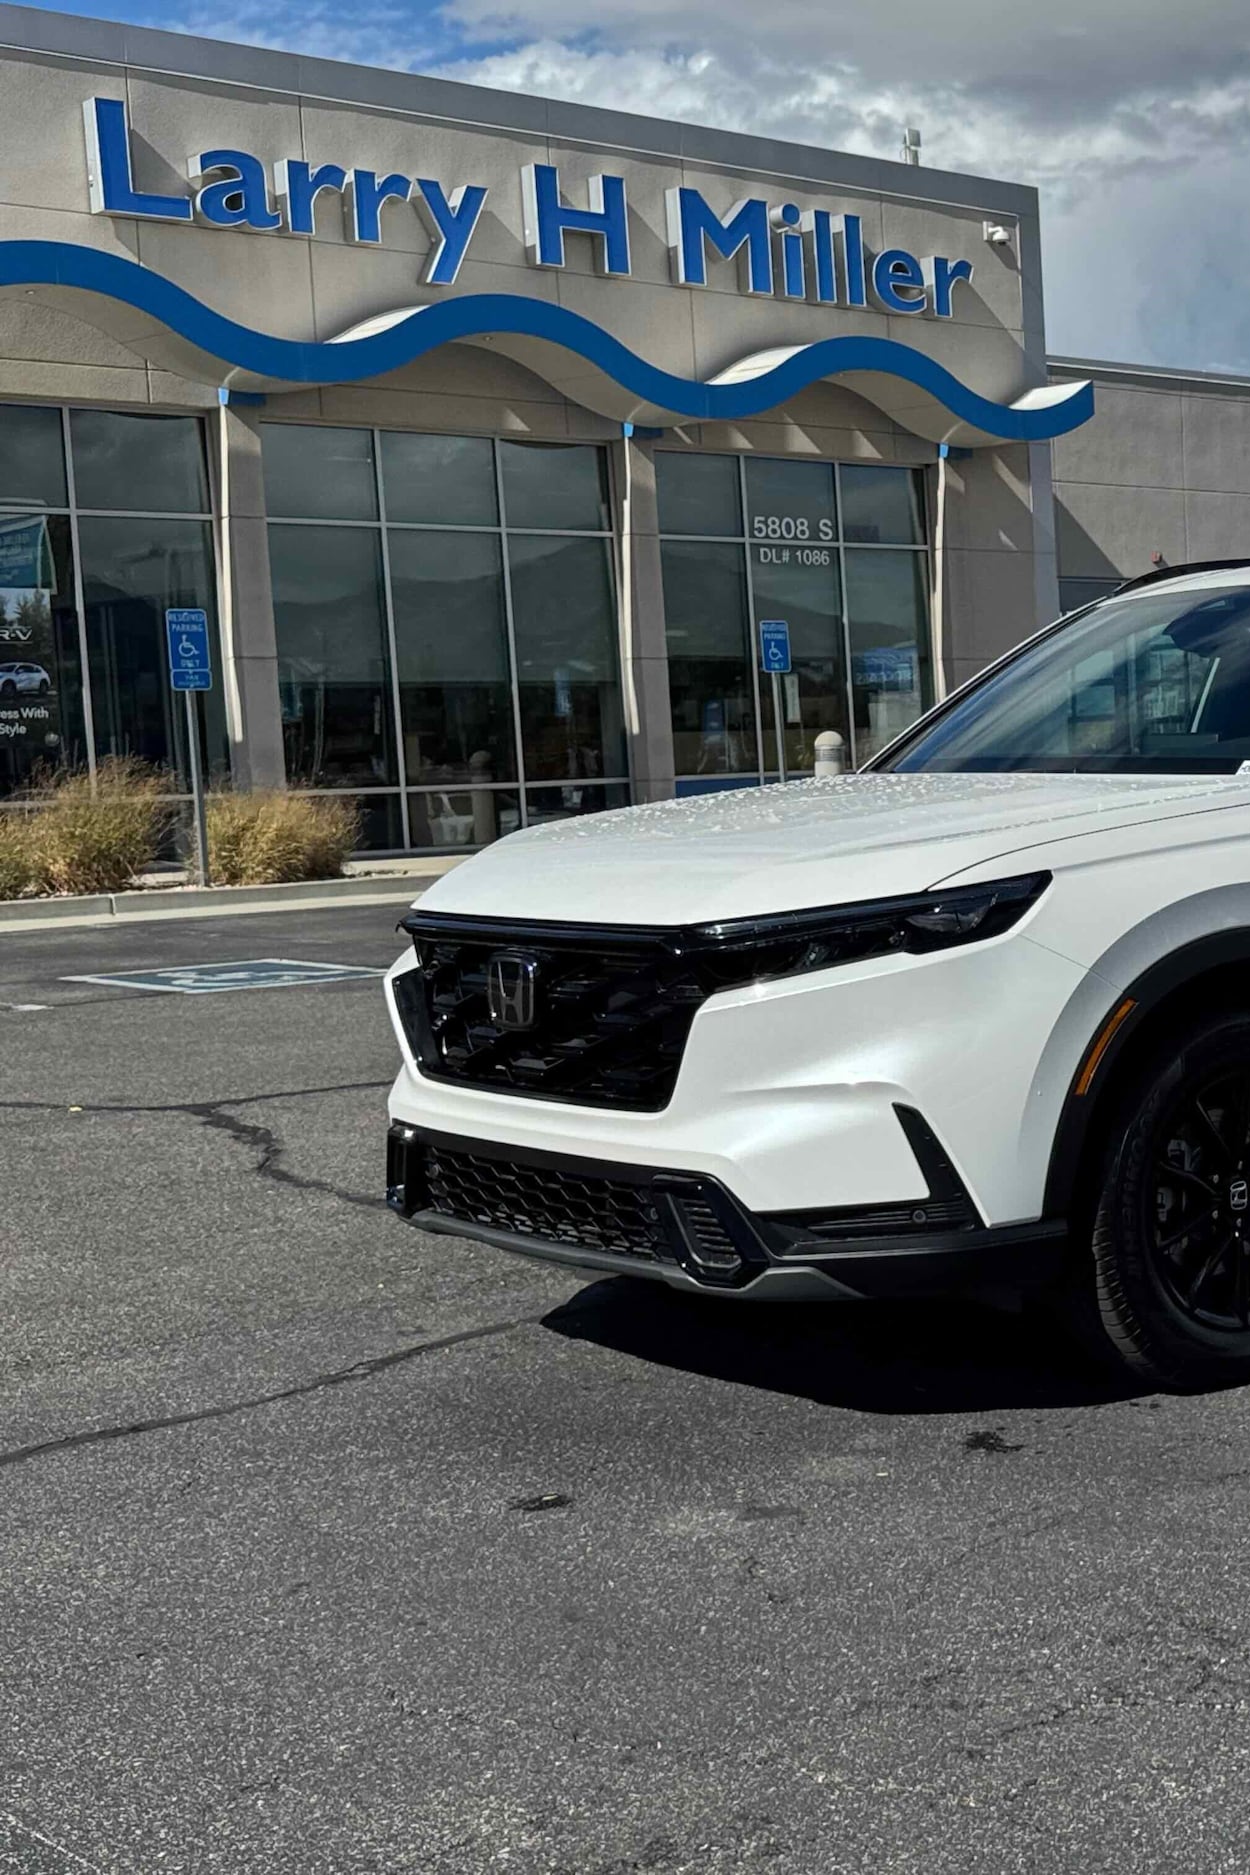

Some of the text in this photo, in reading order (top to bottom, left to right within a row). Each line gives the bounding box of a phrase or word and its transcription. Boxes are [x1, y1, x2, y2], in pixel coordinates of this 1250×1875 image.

[84, 97, 973, 318] Larry H Miller
[754, 516, 833, 540] 5808 S
[760, 547, 830, 565] DL# 1086
[20, 706, 49, 719] With
[0, 722, 27, 738] Style
